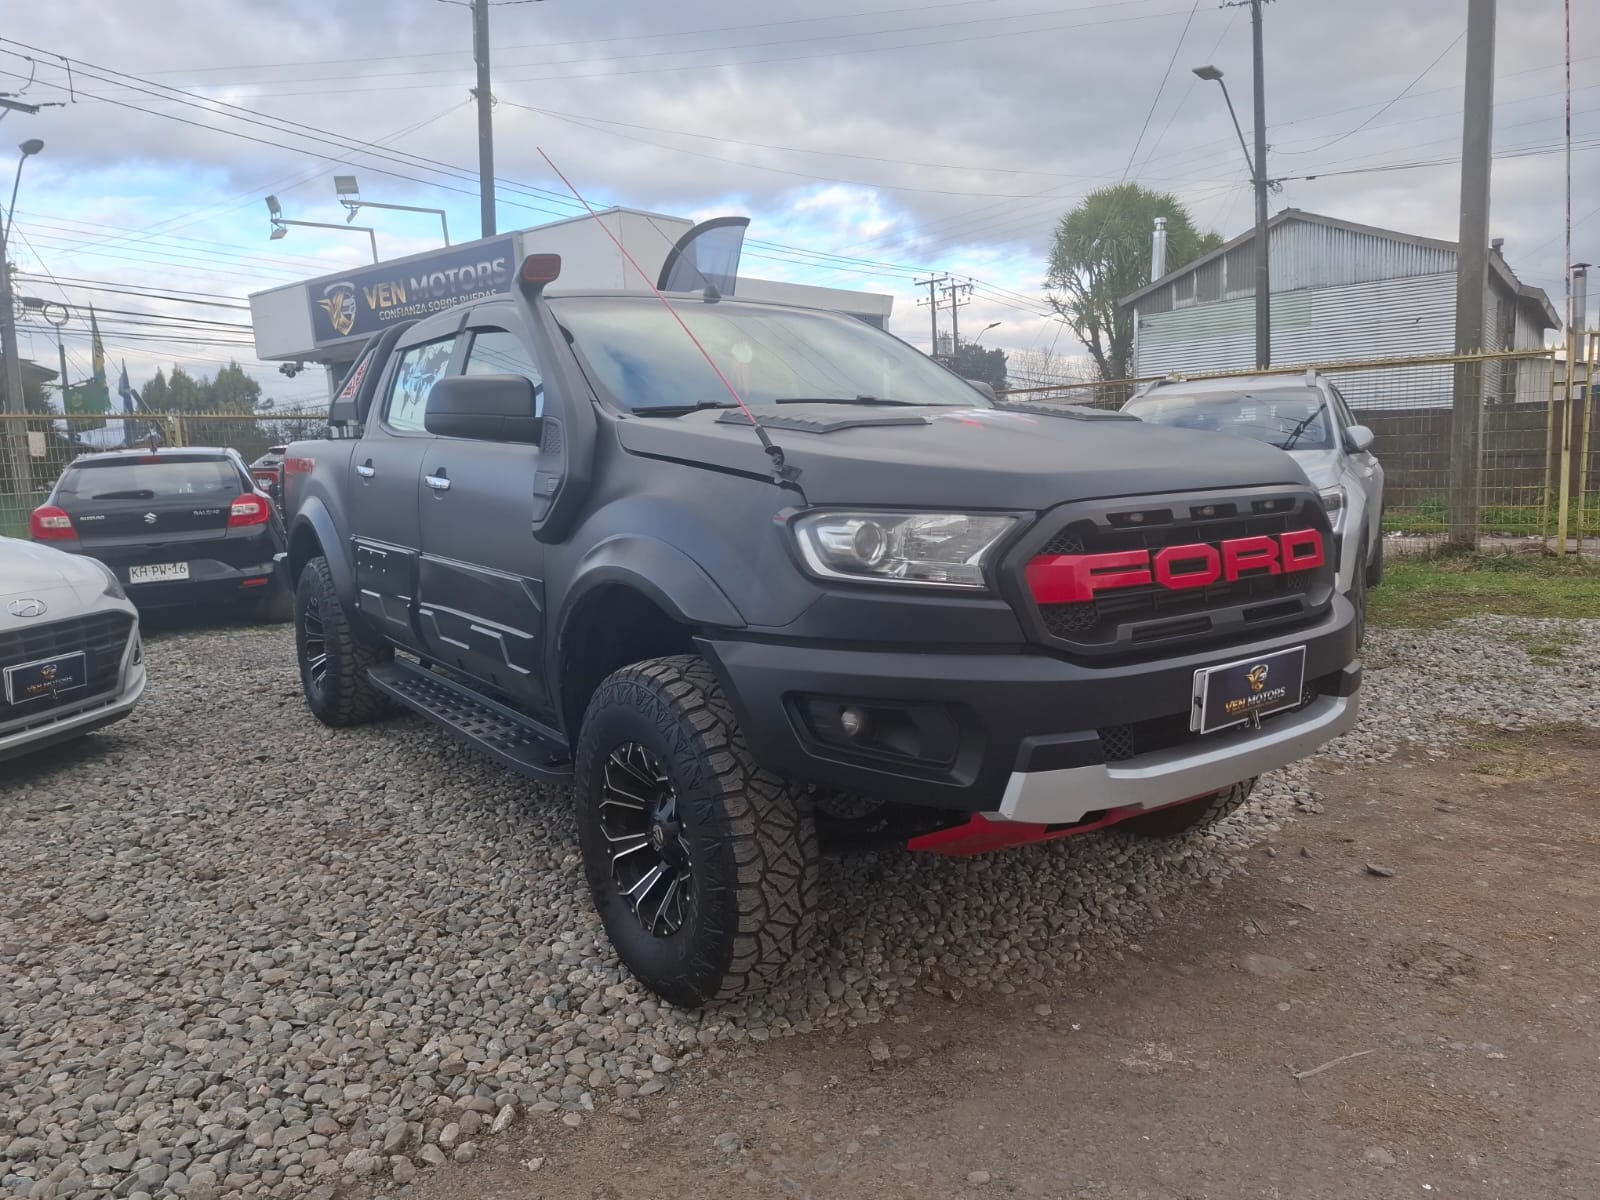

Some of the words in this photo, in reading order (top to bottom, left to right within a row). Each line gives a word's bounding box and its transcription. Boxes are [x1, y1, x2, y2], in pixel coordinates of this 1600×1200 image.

[363, 279, 407, 310] VEN
[410, 257, 505, 301] MOTORS
[379, 304, 427, 321] CONFIANZA
[1025, 528, 1325, 603] FORD
[1225, 697, 1246, 712] VEN
[1247, 686, 1286, 706] MOTORS
